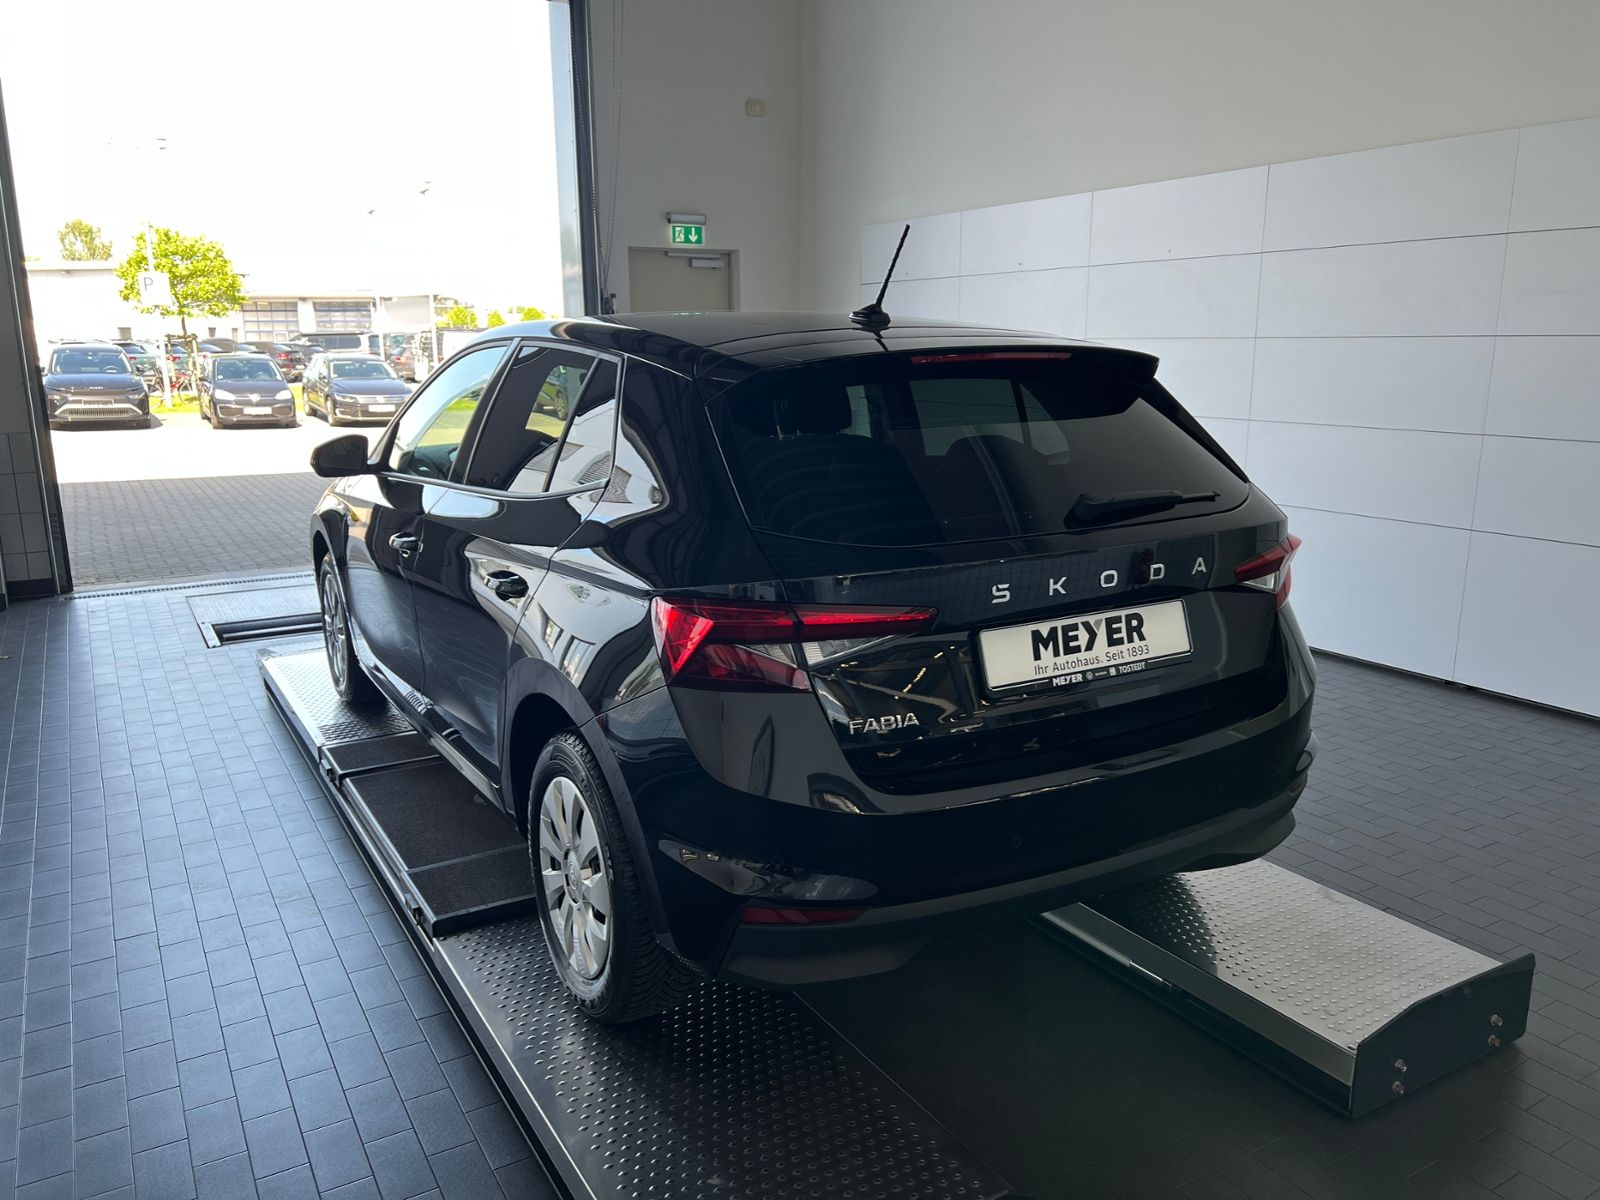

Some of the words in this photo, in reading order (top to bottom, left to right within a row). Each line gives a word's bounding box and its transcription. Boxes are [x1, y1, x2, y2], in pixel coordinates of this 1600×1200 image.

[143, 277, 154, 292] P
[1031, 612, 1147, 661] MEYER
[1034, 664, 1049, 676] Ihr
[1052, 655, 1104, 673] Autohaus.
[1105, 649, 1125, 662] Seit
[1127, 644, 1150, 658] 1893
[1052, 673, 1084, 686] MEYER
[1118, 661, 1146, 674] TOSTEDT
[849, 713, 920, 735] FABIA
